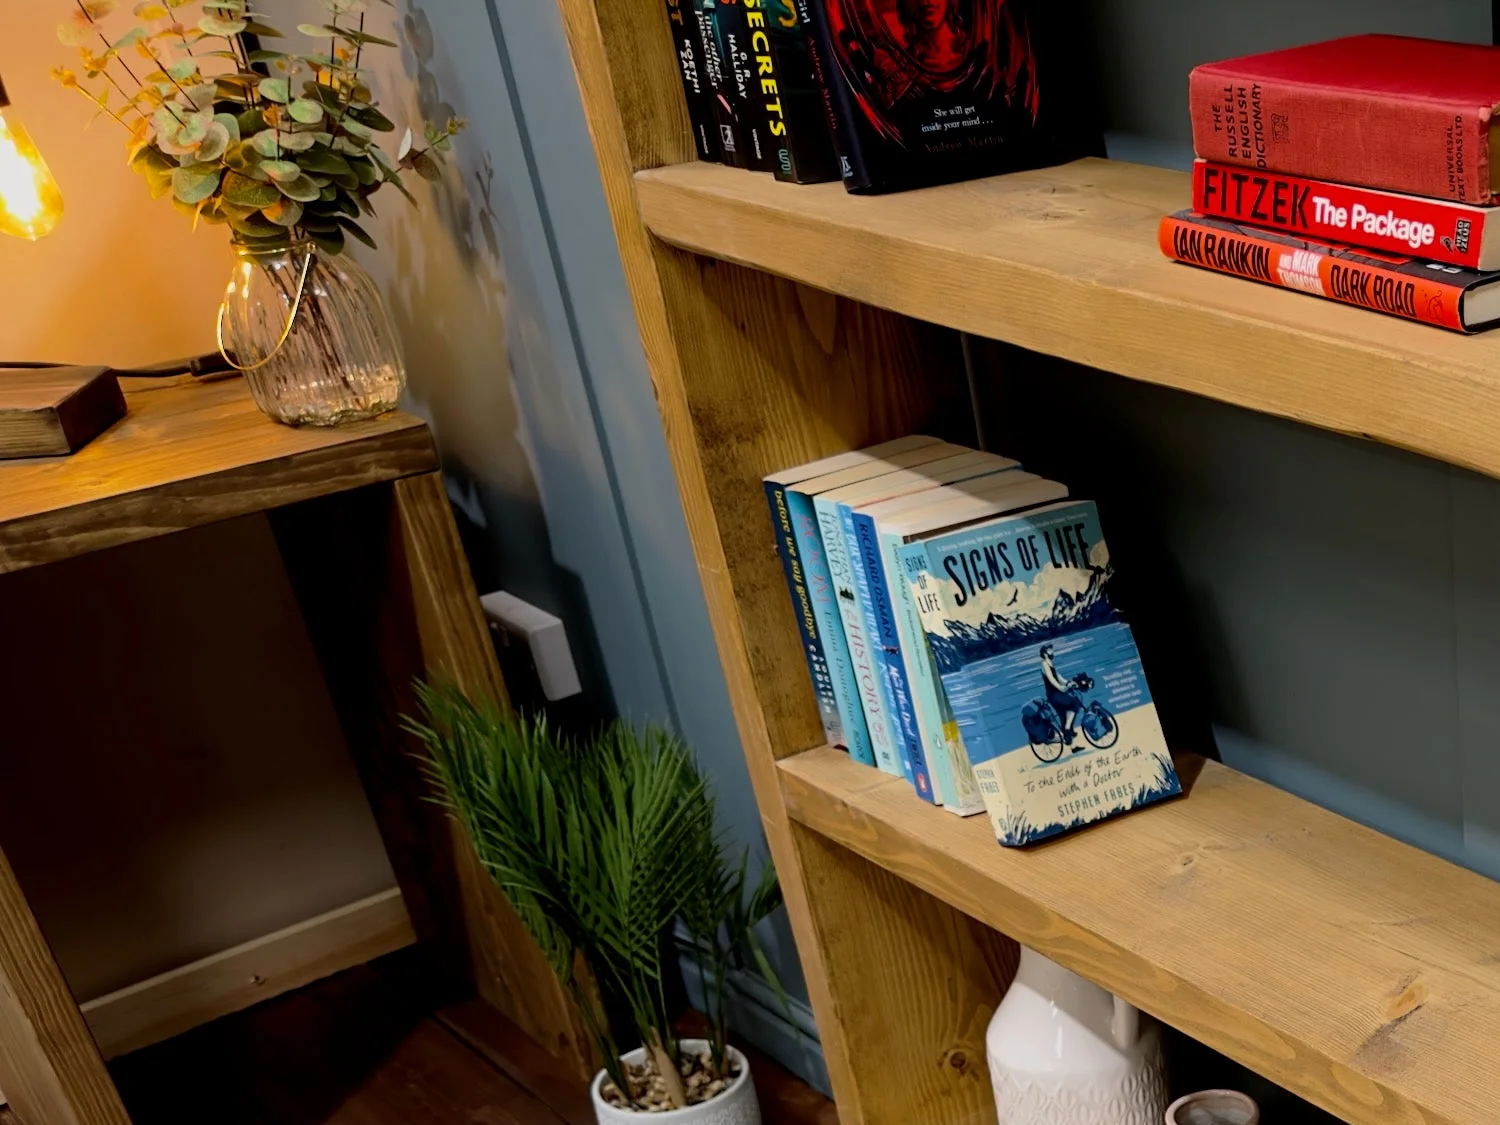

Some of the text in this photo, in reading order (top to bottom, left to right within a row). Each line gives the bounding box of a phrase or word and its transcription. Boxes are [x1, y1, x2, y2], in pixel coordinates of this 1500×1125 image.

[680, 50, 693, 81] ZAN
[683, 38, 701, 94] KOETHI
[694, 10, 719, 90] passenger
[704, 15, 723, 83] the other
[728, 34, 748, 98] HALLIDAY
[739, 51, 752, 84] G. R.
[743, 0, 787, 137] SECRETS
[920, 122, 943, 133] inside
[943, 120, 961, 131] your
[961, 116, 981, 127] mind
[933, 105, 976, 118] She will get
[1211, 104, 1222, 133] THE
[1223, 83, 1238, 158] RUSSELL
[1237, 87, 1252, 159] ENGLISH
[1251, 83, 1267, 169] DICTIONARY
[1446, 123, 1456, 193] UNIVERSAL
[1454, 113, 1466, 201] TEXT BOOKS LTD.
[1202, 167, 1312, 230] FITZEK
[1312, 195, 1435, 249] The Package
[1173, 225, 1272, 282] IAN RANKIN
[1455, 220, 1464, 248] HEAD
[1290, 249, 1322, 278] MARK
[1329, 263, 1417, 318] DARK ROAD
[774, 490, 817, 640] before we say goodbye
[818, 510, 843, 578] HARVEY
[905, 554, 928, 573] SIGNS
[943, 542, 1015, 607] SIGNS
[1016, 534, 1041, 572] OF
[1044, 522, 1092, 571] LIFE
[859, 522, 880, 585] RICHARD
[874, 586, 892, 639] OSMAN
[917, 574, 928, 590] OF
[917, 592, 941, 614] LIFE
[808, 644, 833, 714] CANDLISH
[817, 655, 835, 706] LOUISE
[848, 623, 882, 718] HISTORY
[1023, 746, 1143, 794] To the Ends of the Earth
[1058, 768, 1124, 799] with a Doctor
[1057, 782, 1136, 818] STEPHEN FABES
